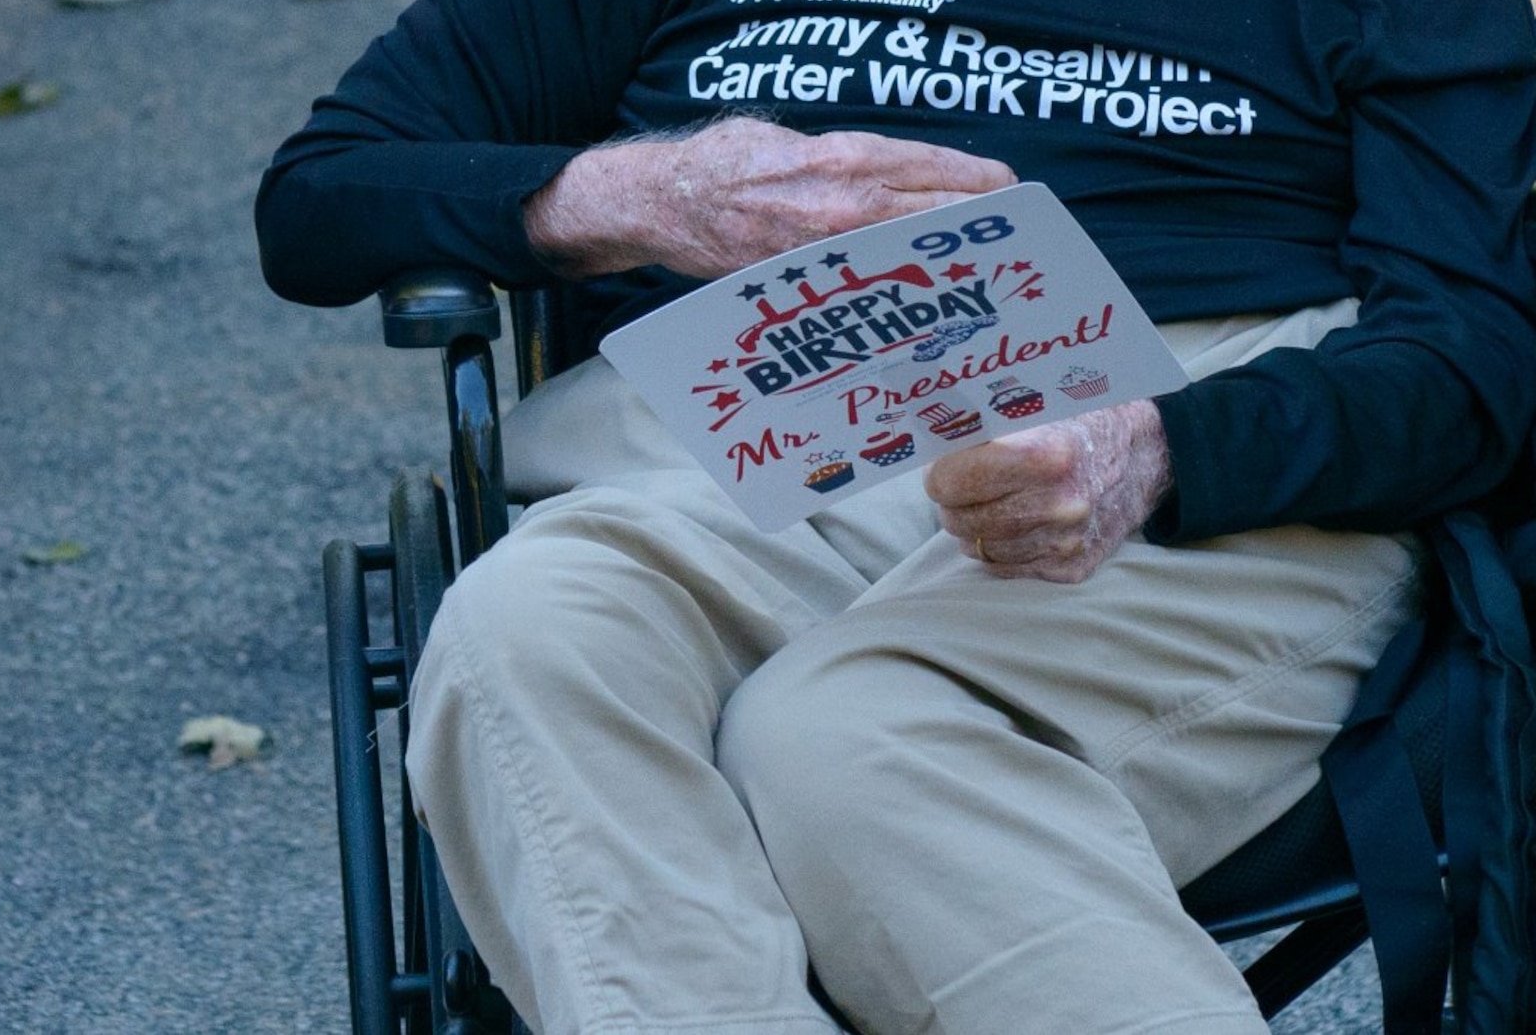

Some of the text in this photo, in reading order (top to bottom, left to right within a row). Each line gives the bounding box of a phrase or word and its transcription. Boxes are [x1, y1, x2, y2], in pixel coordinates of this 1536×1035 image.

[884, 17, 930, 62] &
[688, 54, 1257, 137] Carter Work Project
[911, 215, 1015, 259] 98
[743, 279, 998, 396] BIRTHDAY
[764, 284, 904, 352] HAPPY
[726, 427, 820, 483] Mr.
[838, 304, 1114, 425] President!
